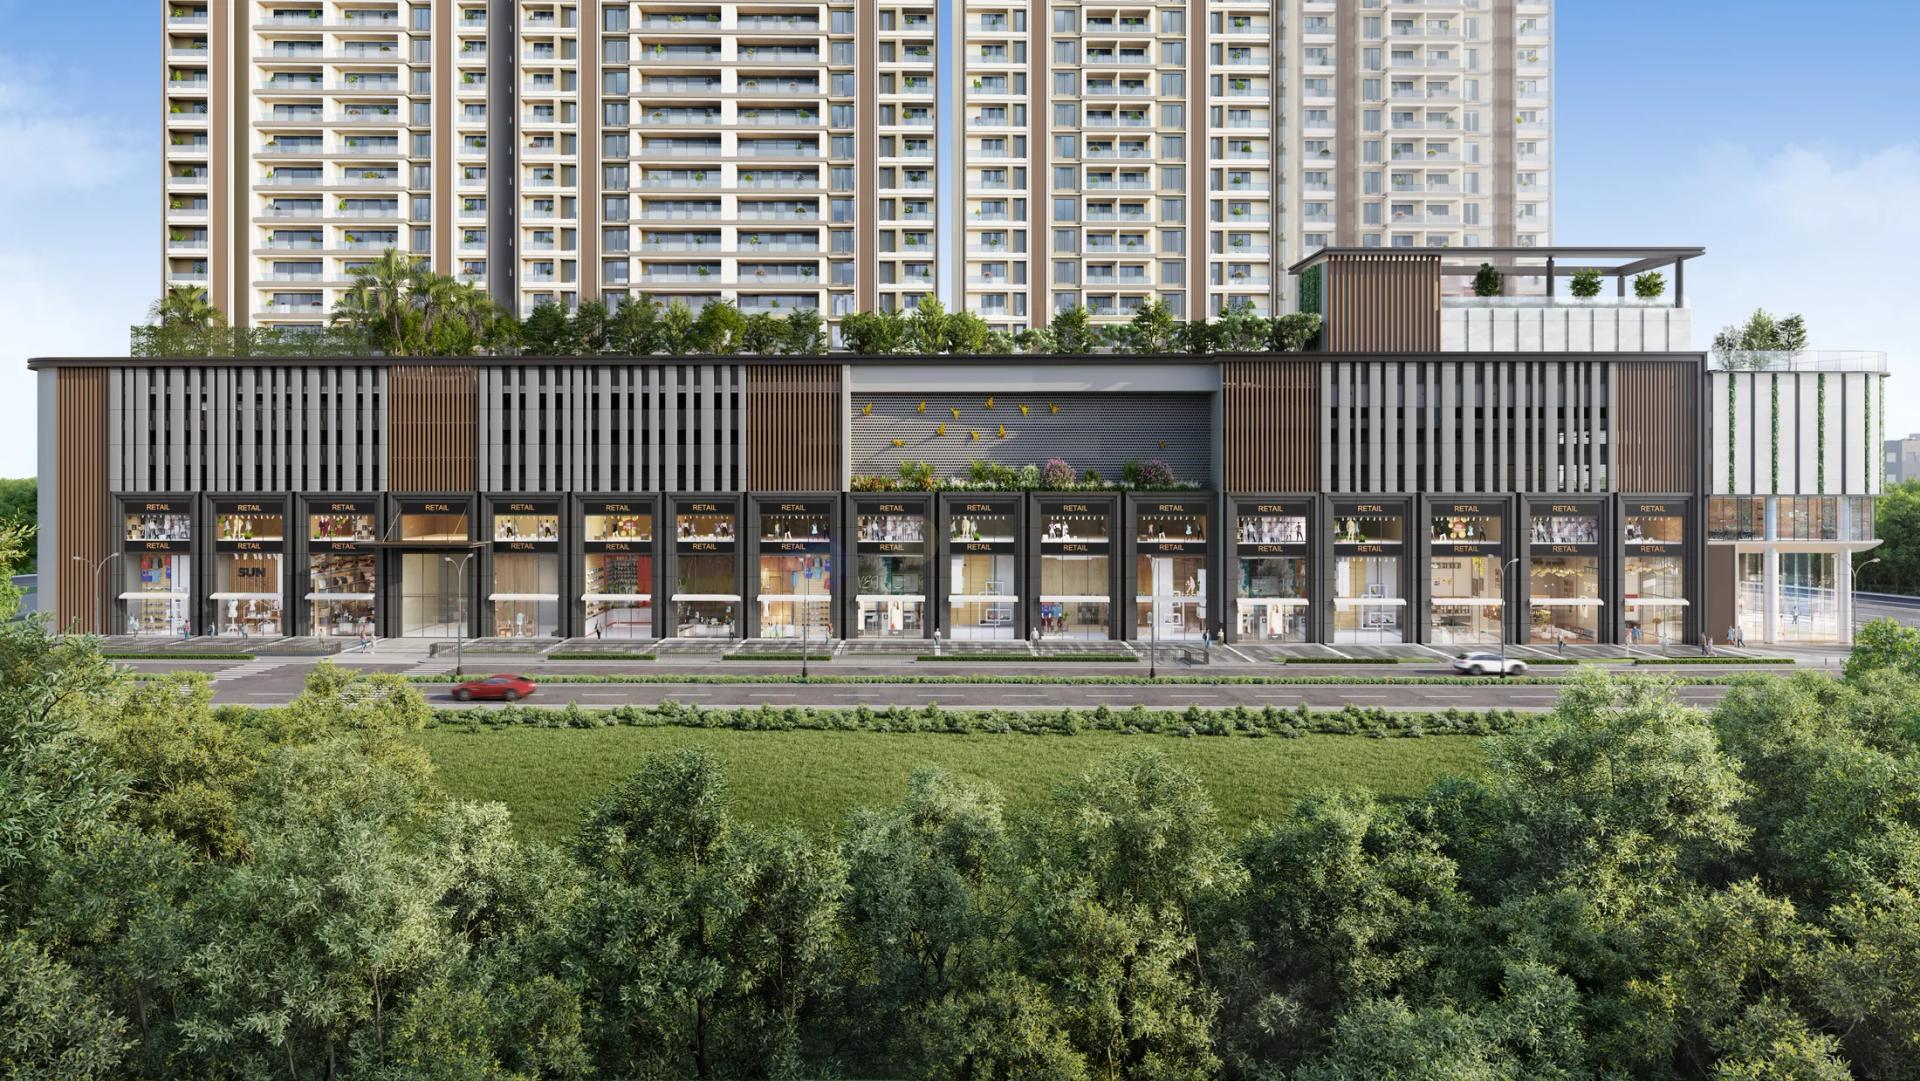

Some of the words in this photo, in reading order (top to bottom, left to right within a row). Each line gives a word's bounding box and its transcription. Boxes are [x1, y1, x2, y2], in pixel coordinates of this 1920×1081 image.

[146, 504, 170, 512] RETAIL
[238, 504, 262, 512] RETAIL
[332, 504, 356, 512] RETAIL
[424, 504, 448, 512] RETAIL
[510, 504, 534, 512] RETAIL
[606, 504, 630, 512] RETAIL
[692, 504, 716, 512] RETAIL
[782, 504, 806, 512] RETAIL
[880, 504, 904, 512] RETAIL
[966, 504, 992, 512] RETAIL
[1064, 504, 1088, 512] RETAIL
[1158, 504, 1184, 512] RETAIL
[1258, 506, 1284, 514] RETAIL
[1358, 504, 1382, 512] RETAIL
[1454, 506, 1480, 514] RETAIL
[1552, 506, 1578, 514] RETAIL
[1640, 506, 1666, 514] RETAIL
[146, 542, 170, 550] RETAIL
[238, 542, 262, 550] RETAIL
[332, 542, 356, 550] RETAIL
[510, 542, 534, 550] RETAIL
[606, 542, 630, 550] RETAIL
[692, 542, 716, 550] RETAIL
[780, 542, 806, 550] RETAIL
[880, 542, 904, 551] RETAIL
[966, 542, 992, 550] RETAIL
[1064, 543, 1088, 552] RETAIL
[1158, 543, 1184, 552] RETAIL
[1258, 544, 1284, 552] RETAIL
[1358, 544, 1382, 552] RETAIL
[1454, 544, 1478, 552] RETAIL
[1552, 544, 1578, 552] RETAIL
[1640, 544, 1666, 552] RETAIL
[238, 568, 266, 577] SUN
